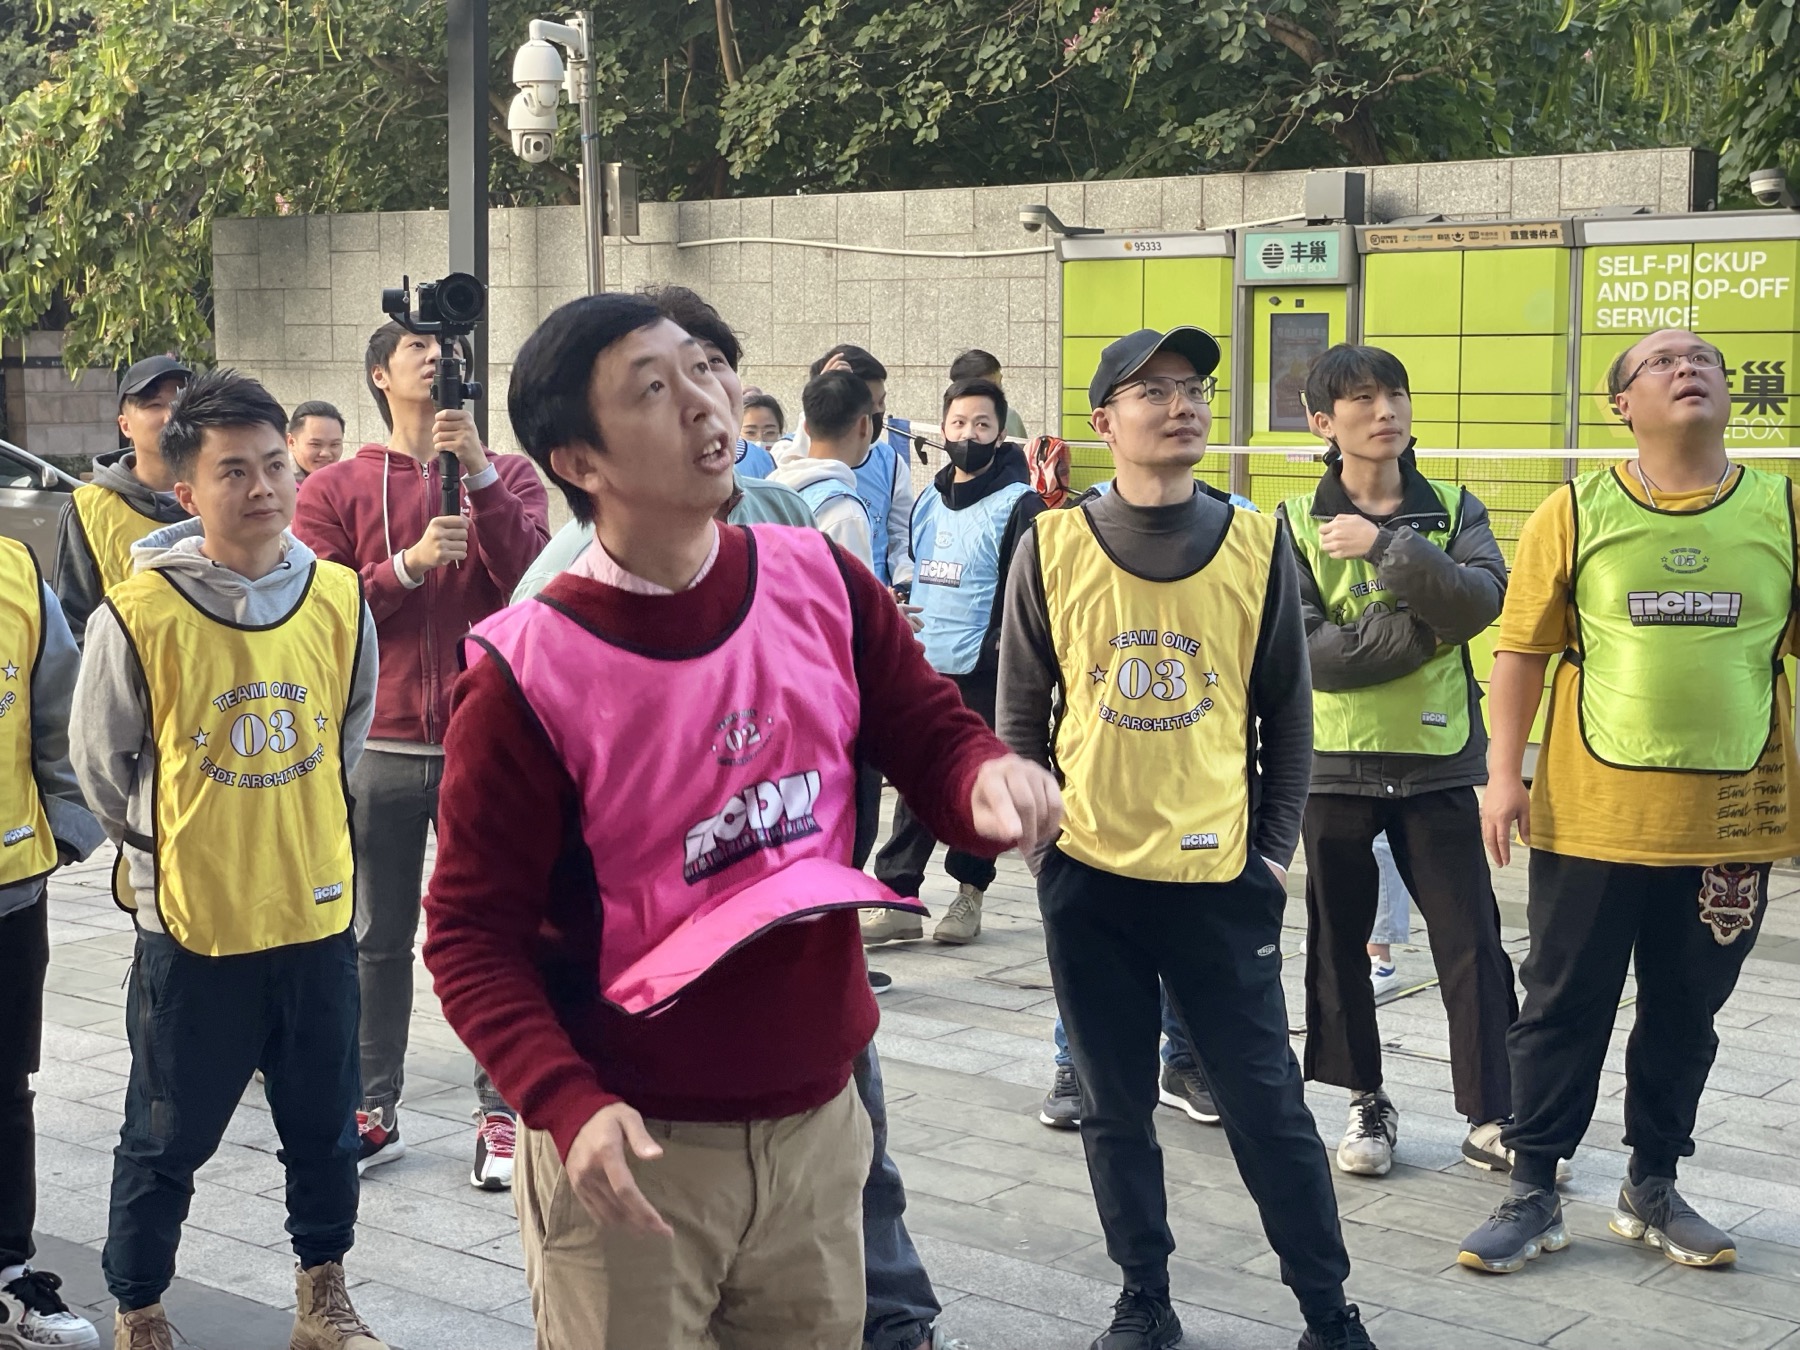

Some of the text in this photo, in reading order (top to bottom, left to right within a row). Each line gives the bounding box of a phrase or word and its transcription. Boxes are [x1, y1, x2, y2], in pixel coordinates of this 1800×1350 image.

[1134, 241, 1162, 251] 95333
[1290, 241, 1327, 263] 丰巢
[1284, 263, 1327, 273] HIVE BOX
[1598, 252, 1767, 276] SELF-PICKUP
[1597, 278, 1790, 302] AND DROP-OFF
[1597, 306, 1700, 328] SERVICE
[1732, 418, 1785, 440] BOX
[1673, 554, 1697, 566] 05
[1109, 630, 1201, 657] TEAM ONE
[1117, 657, 1187, 701] 03
[213, 681, 308, 713] TEAM ONE
[1118, 697, 1214, 731] ARCHITECTS
[230, 709, 298, 757] 03
[725, 722, 761, 752] 02
[200, 742, 325, 788] TCDI ARCHITECTS
